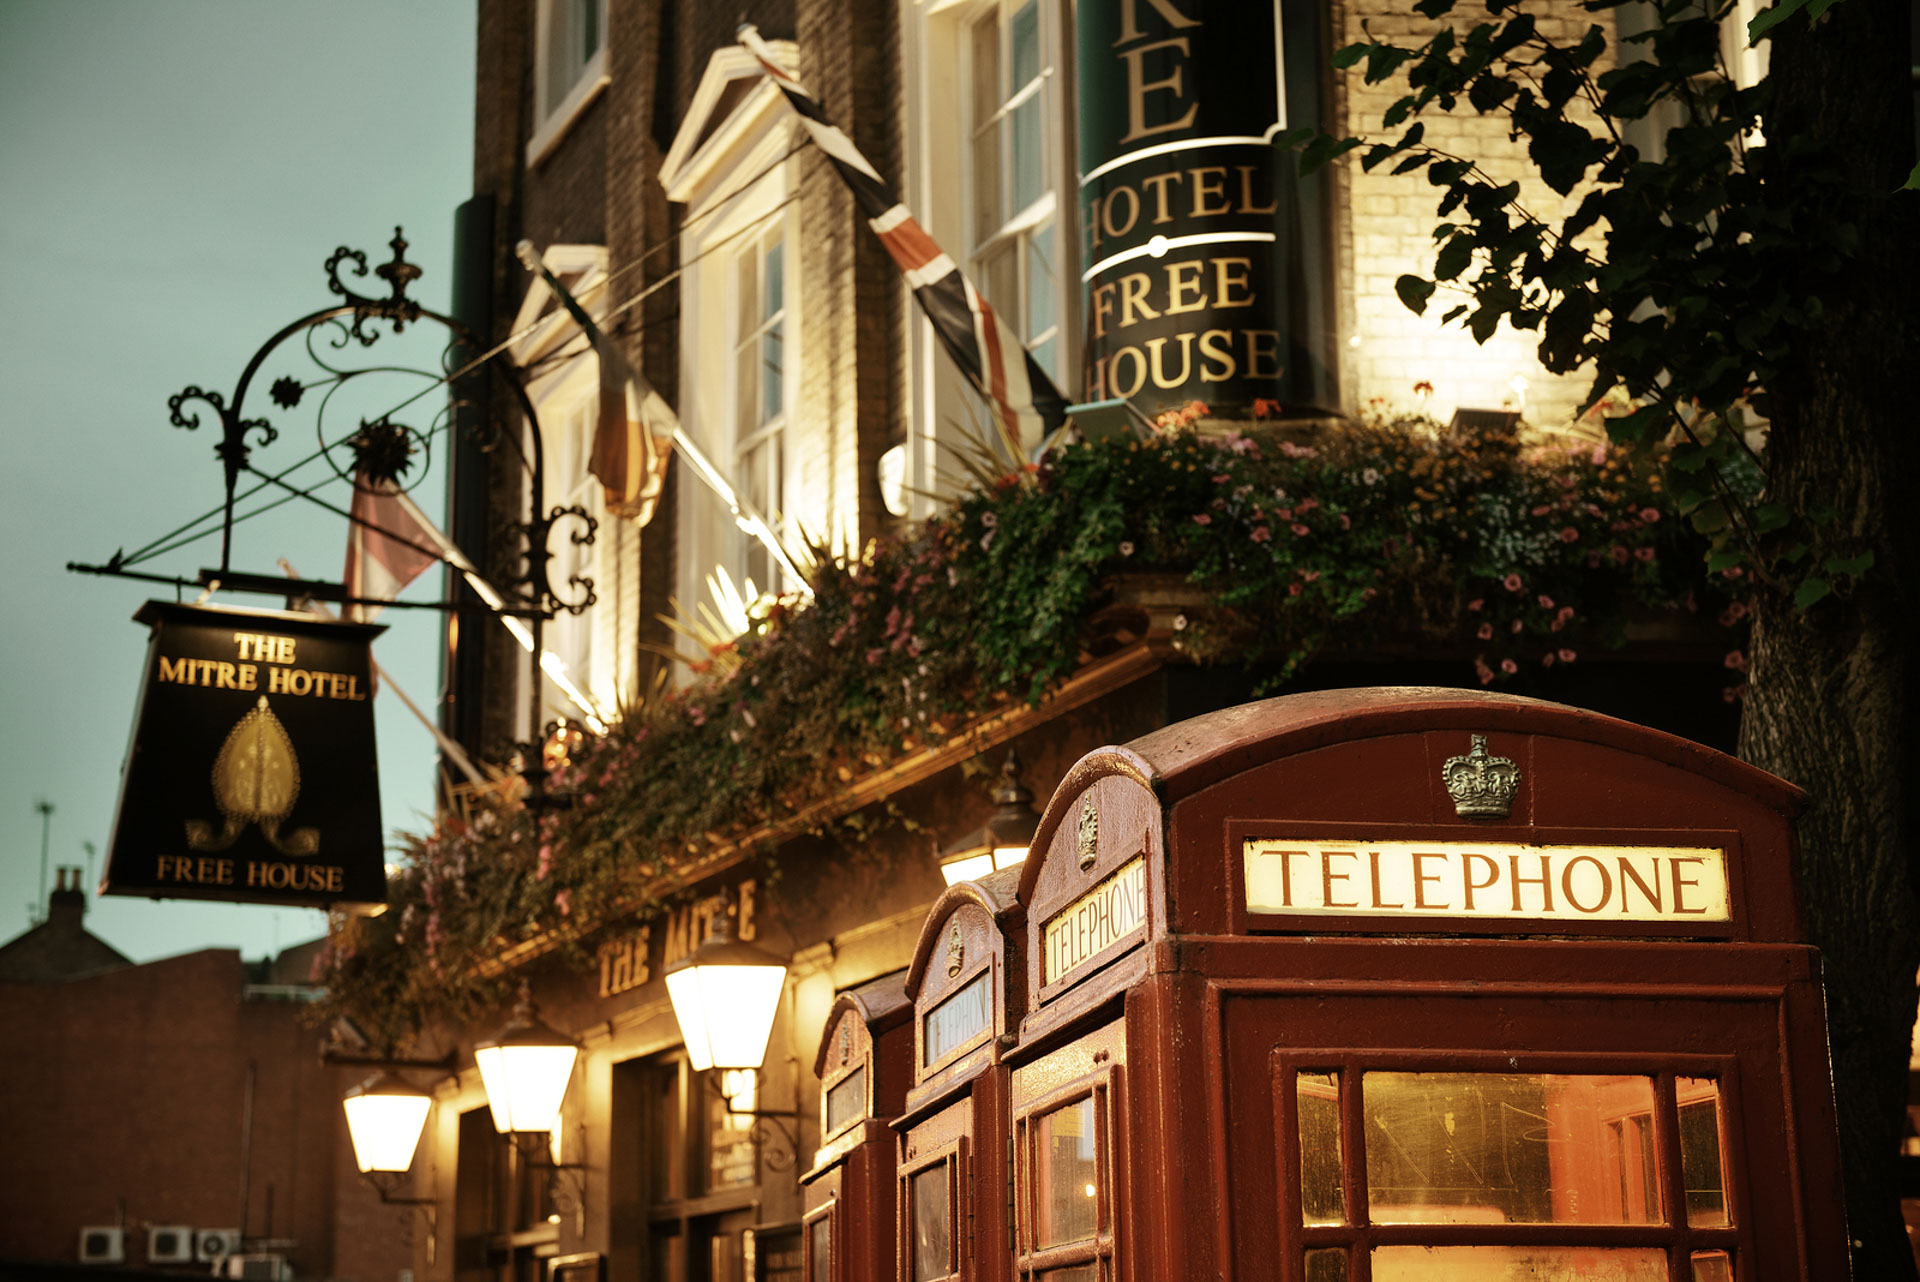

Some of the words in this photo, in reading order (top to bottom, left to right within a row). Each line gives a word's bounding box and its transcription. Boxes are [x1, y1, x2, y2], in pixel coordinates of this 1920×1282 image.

[1082, 166, 1279, 251] HOTEL
[1093, 257, 1256, 339] FREE
[1085, 328, 1285, 402] HOUSE
[158, 656, 258, 691] MITRE
[268, 666, 366, 701] HOTEL
[234, 632, 296, 665] THE
[156, 854, 235, 885] FREE
[247, 859, 344, 893] HOUSE
[1260, 848, 1709, 915] TELEPHONE
[663, 878, 756, 968] MITE
[1050, 867, 1145, 979] TELEPHONE
